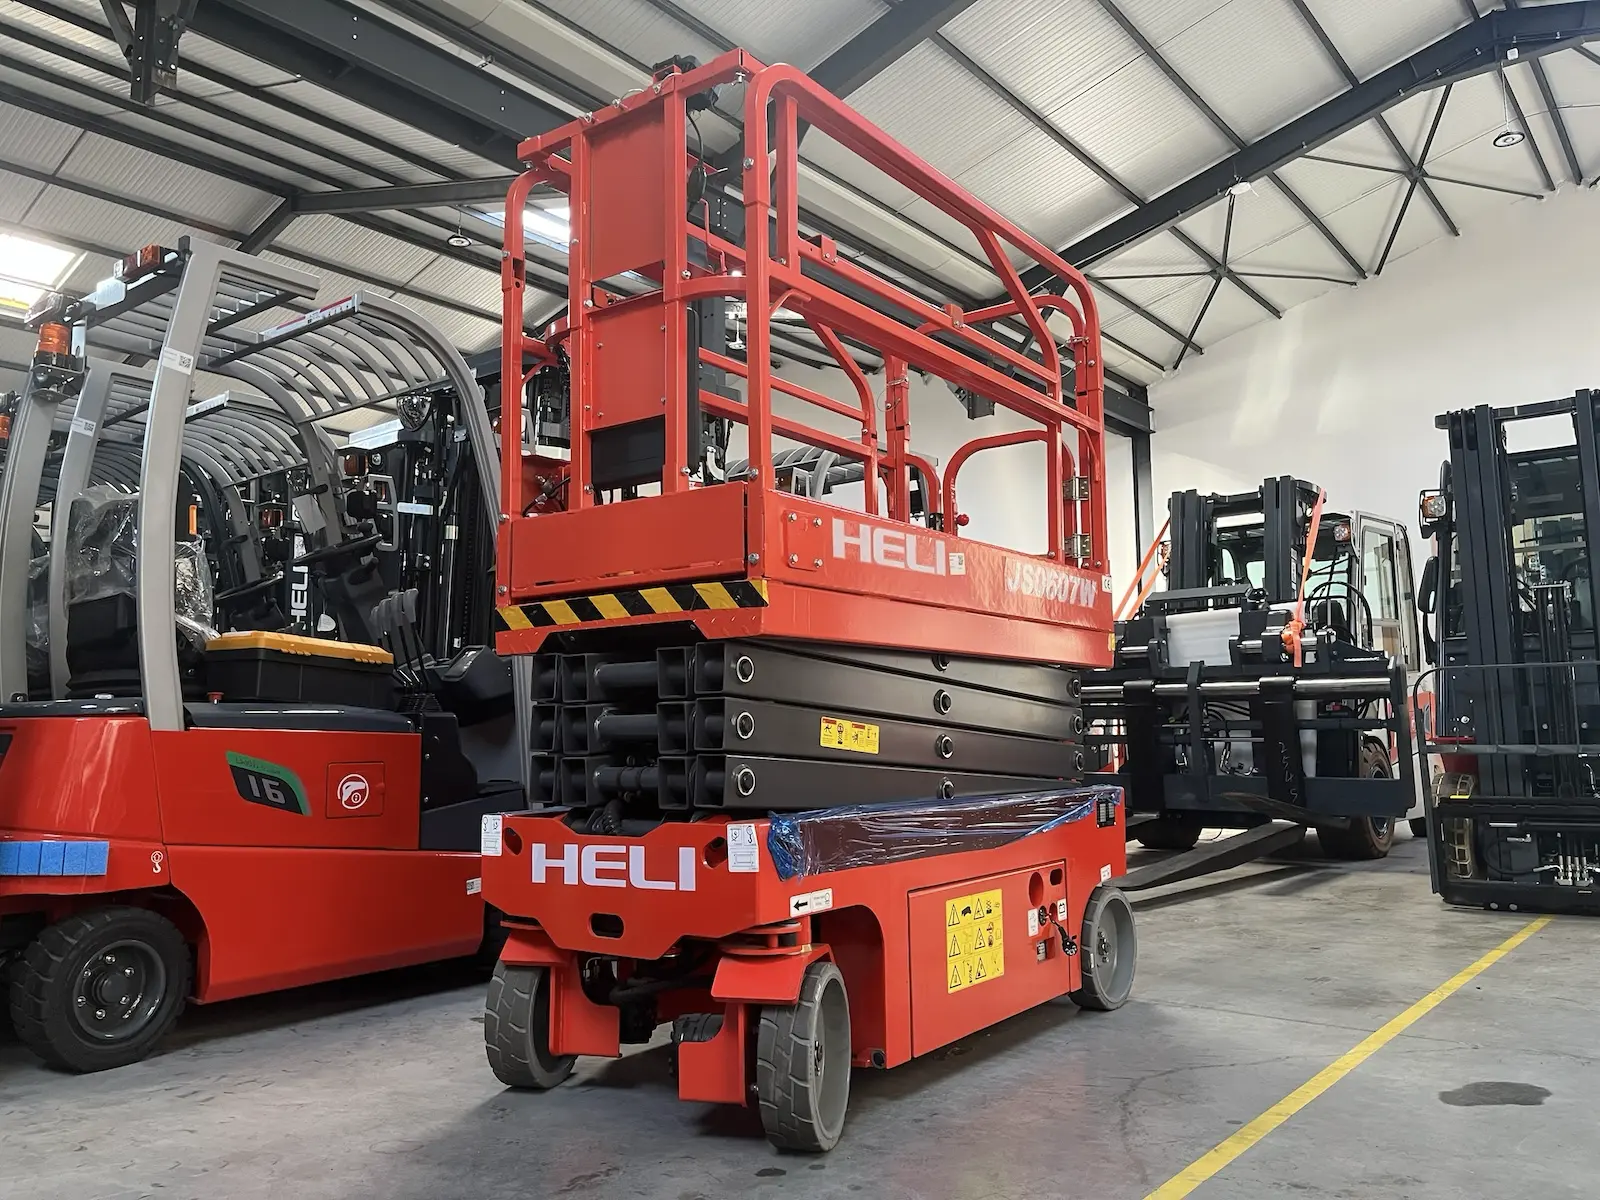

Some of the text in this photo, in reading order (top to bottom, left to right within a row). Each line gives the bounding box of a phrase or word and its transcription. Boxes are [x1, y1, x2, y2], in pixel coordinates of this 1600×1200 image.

[832, 518, 946, 576] HELI
[247, 774, 286, 804] 16
[532, 843, 696, 891] HELI
